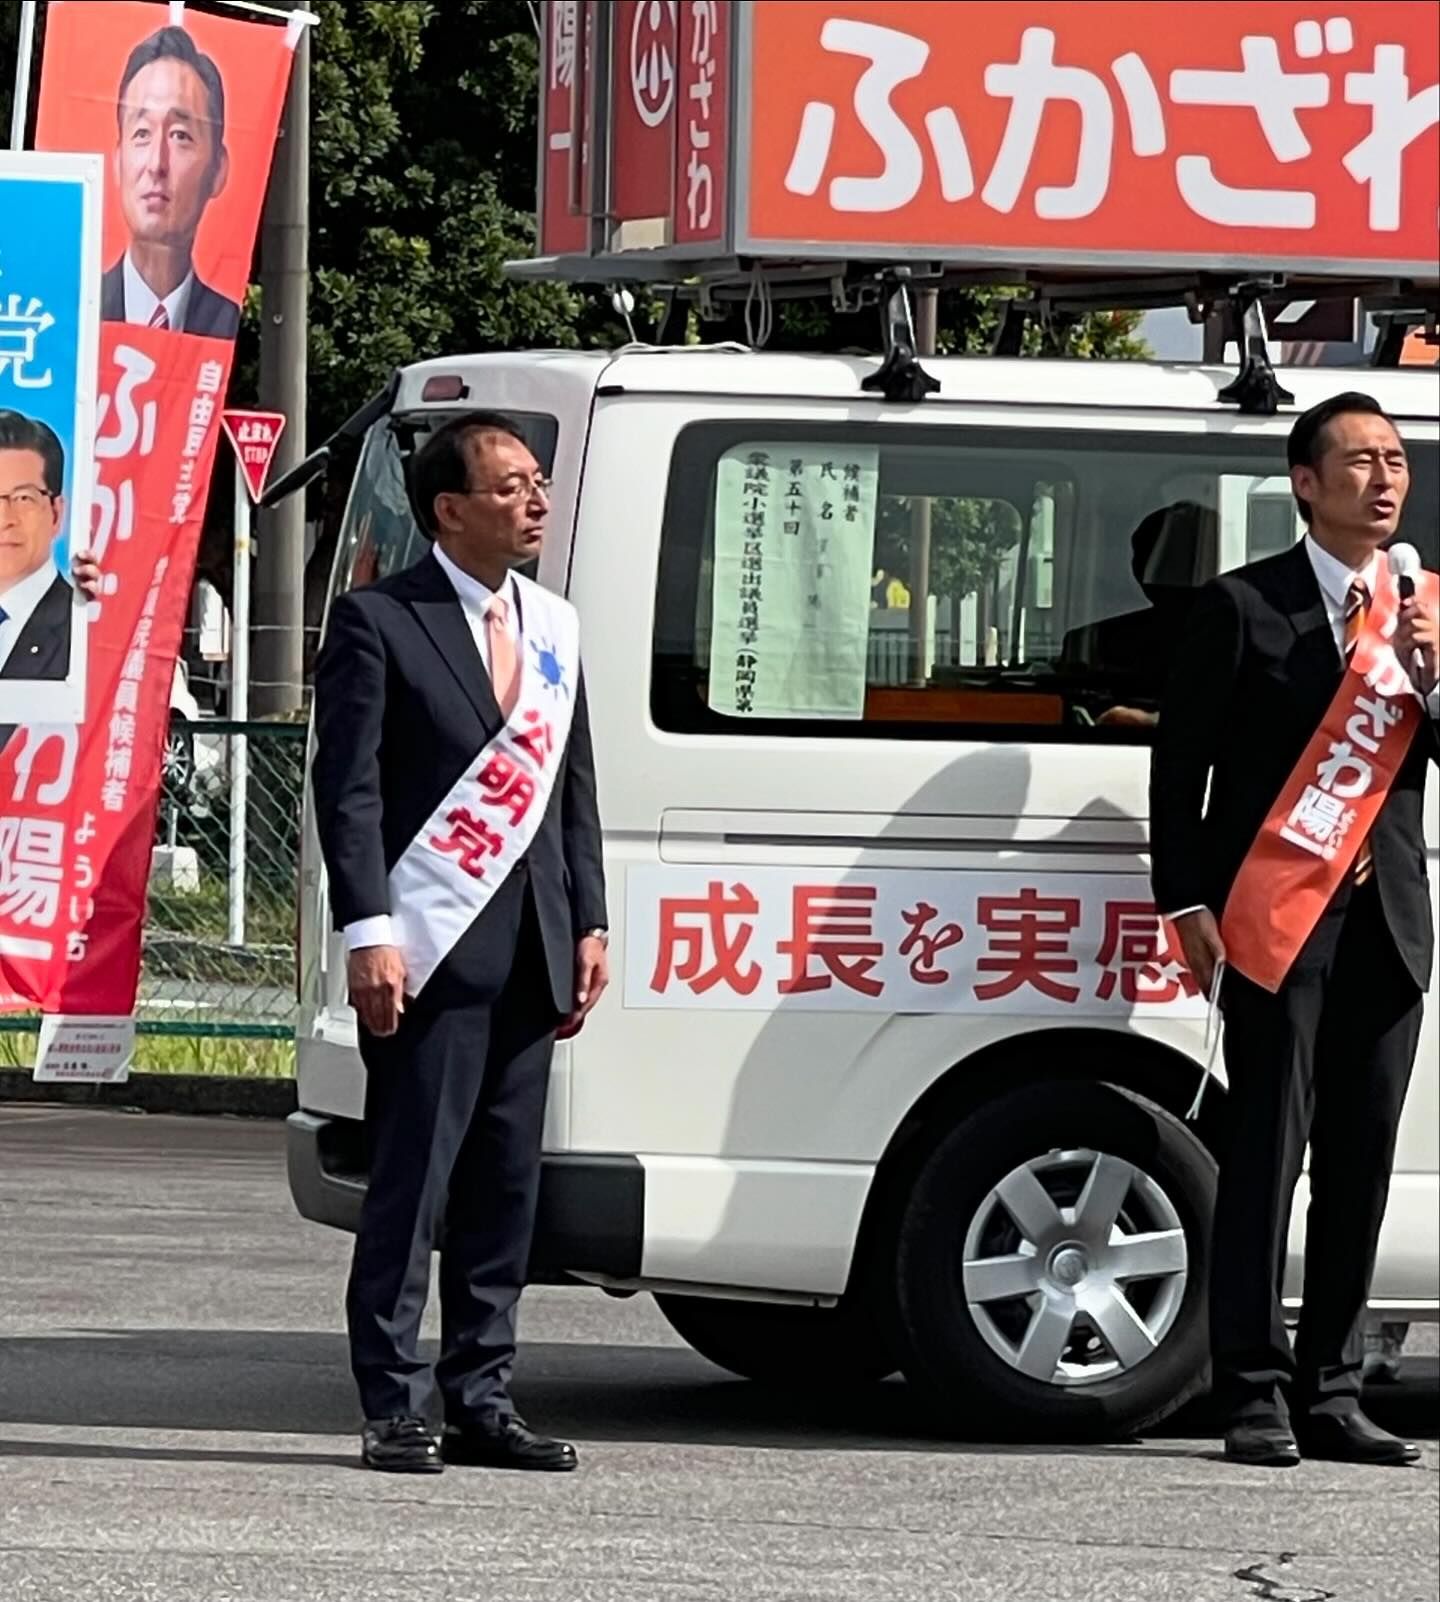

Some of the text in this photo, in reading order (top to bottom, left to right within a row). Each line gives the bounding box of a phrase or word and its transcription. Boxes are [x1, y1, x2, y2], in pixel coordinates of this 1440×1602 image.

[0, 343, 156, 961] ふかわ陽一
[1280, 612, 1404, 858] かざわ陽一
[430, 708, 553, 879] 公明党
[66, 812, 96, 961] よういち
[650, 881, 1200, 1003] 成長を実感
